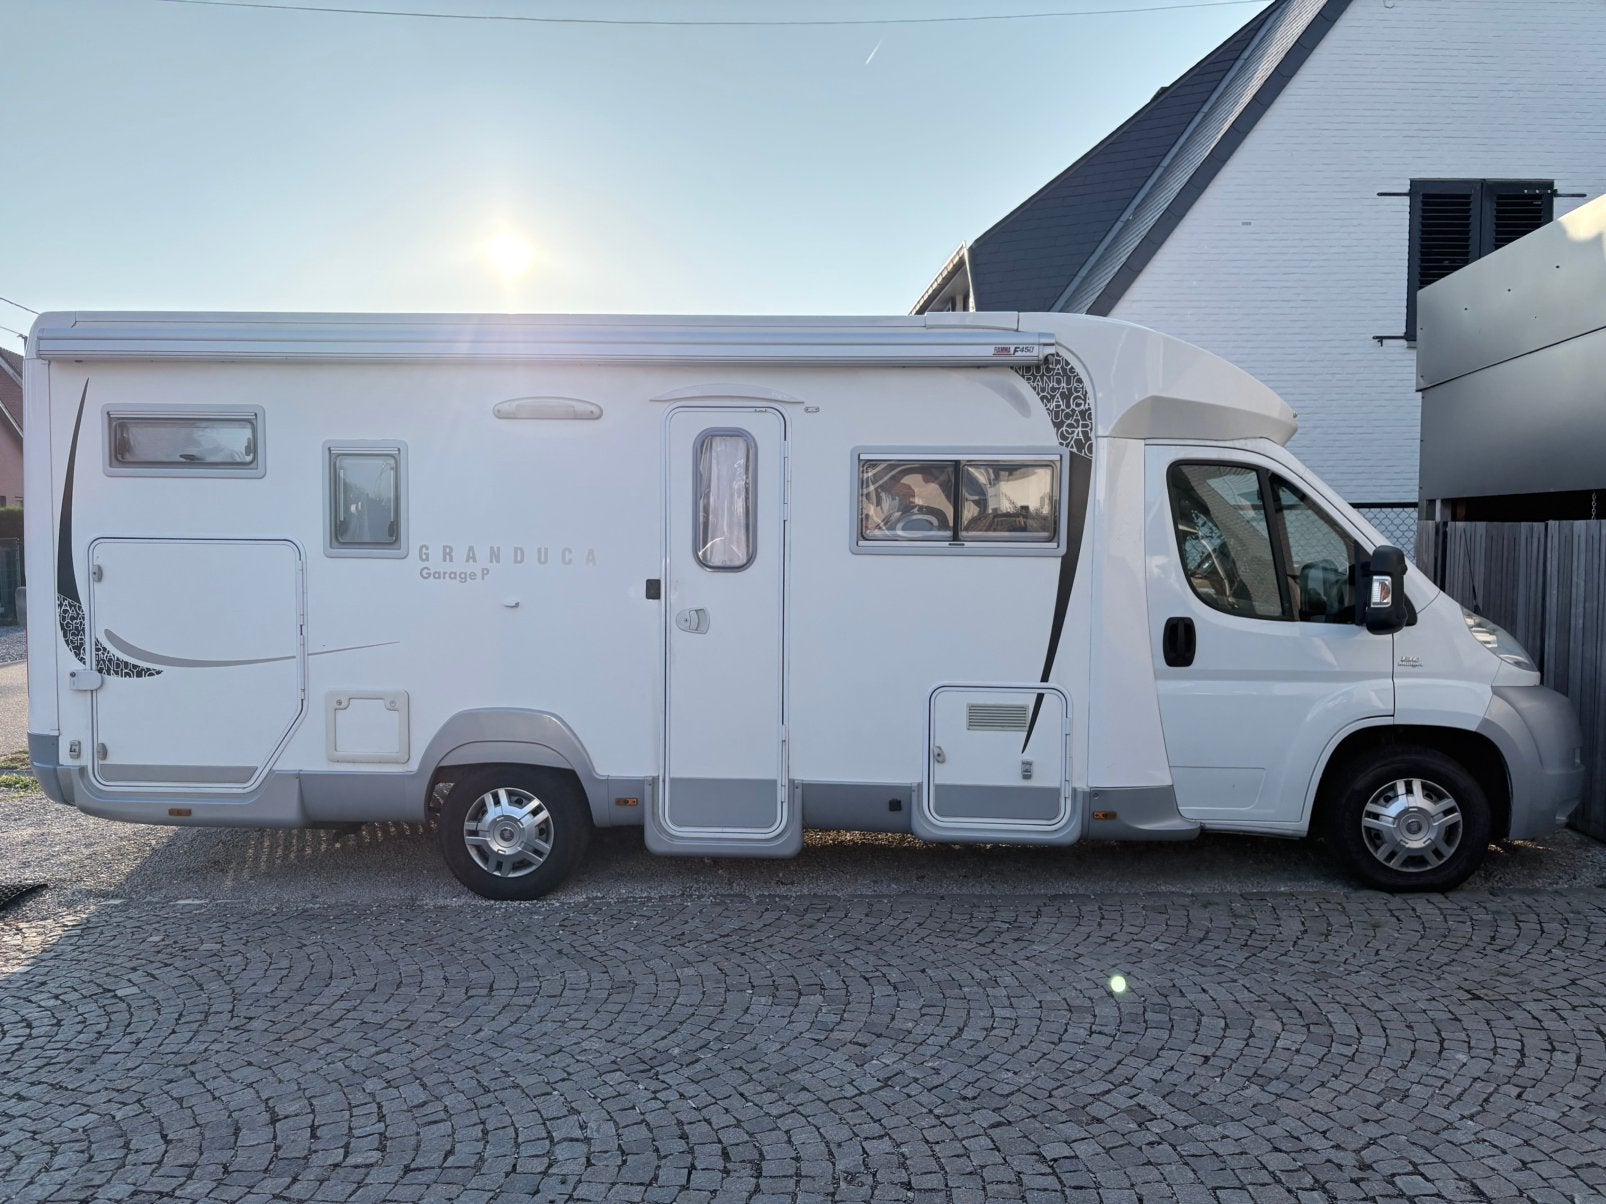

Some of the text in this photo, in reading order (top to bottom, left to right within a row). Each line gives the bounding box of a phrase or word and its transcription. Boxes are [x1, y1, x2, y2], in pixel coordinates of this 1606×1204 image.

[418, 544, 597, 566] GRANDUCA
[419, 566, 490, 583] Garage P
